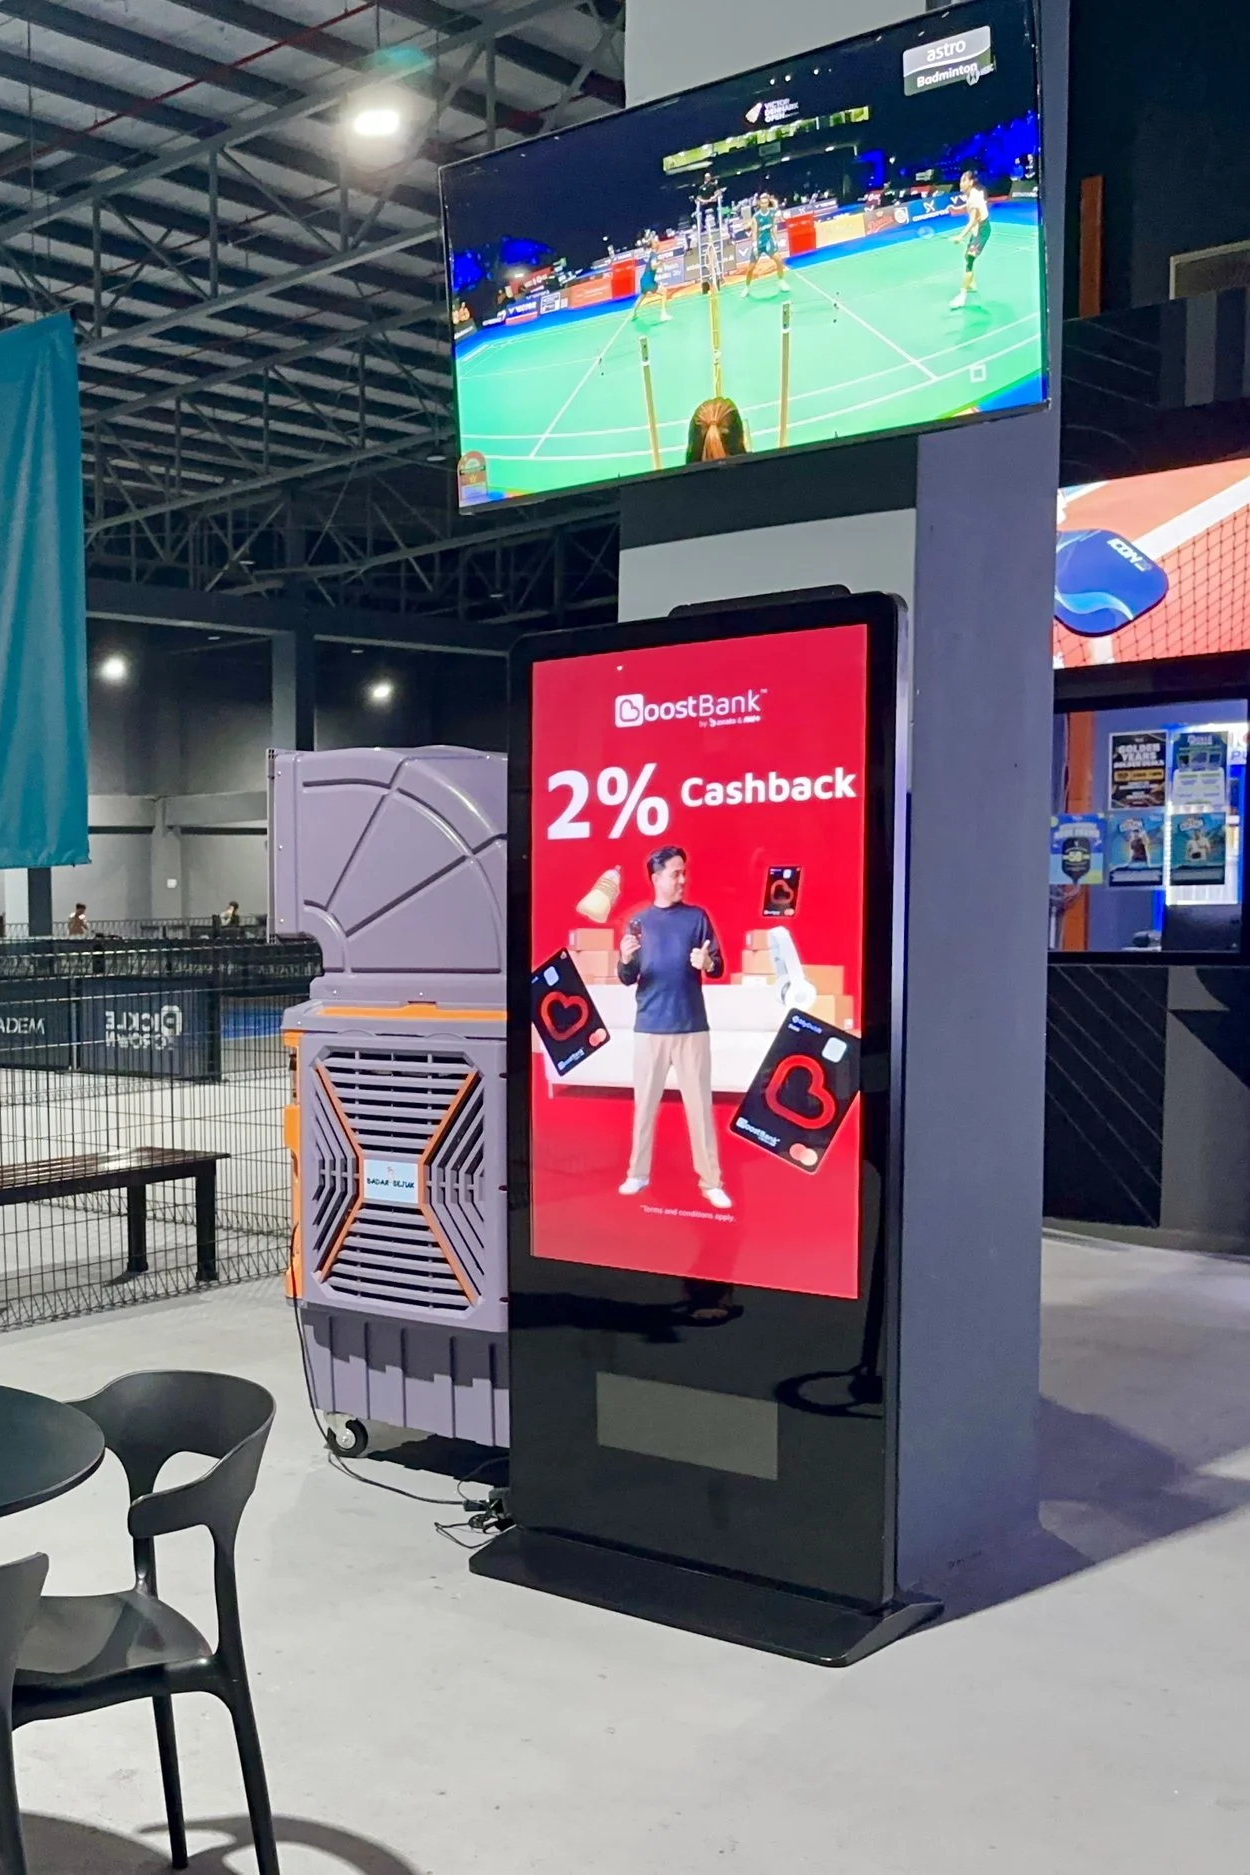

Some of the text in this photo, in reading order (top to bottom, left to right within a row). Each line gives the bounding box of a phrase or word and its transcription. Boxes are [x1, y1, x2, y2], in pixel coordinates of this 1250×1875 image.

[926, 40, 966, 62] astro
[916, 62, 978, 88] Badminton
[764, 112, 786, 123] OPEN
[1106, 538, 1143, 564] ICON
[546, 762, 857, 841] 2% Cashback
